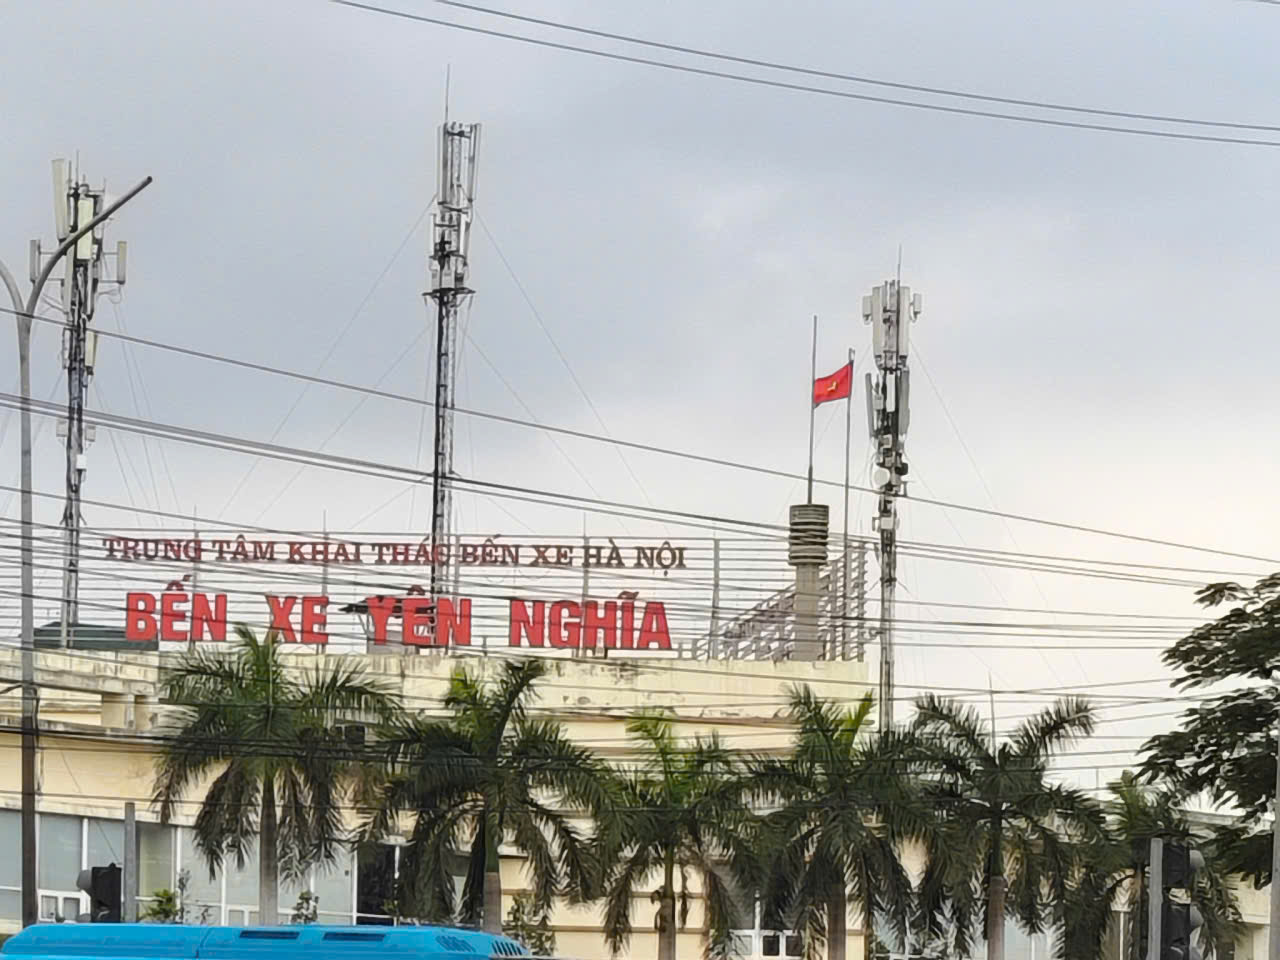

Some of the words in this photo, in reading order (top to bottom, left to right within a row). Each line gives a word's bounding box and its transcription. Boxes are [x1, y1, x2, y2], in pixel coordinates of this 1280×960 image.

[102, 537, 201, 561] TRUNG
[212, 534, 277, 561] TÂM
[288, 541, 362, 565] KHAI
[372, 536, 449, 566] THÁC
[459, 534, 520, 566] BẾN
[531, 545, 575, 567] XE
[582, 537, 625, 568] HÀ
[634, 541, 688, 577] NỘI
[125, 574, 227, 642] BẾN
[265, 590, 330, 645] XE
[366, 584, 472, 646] YÊN
[509, 590, 673, 650] NGHĨA
